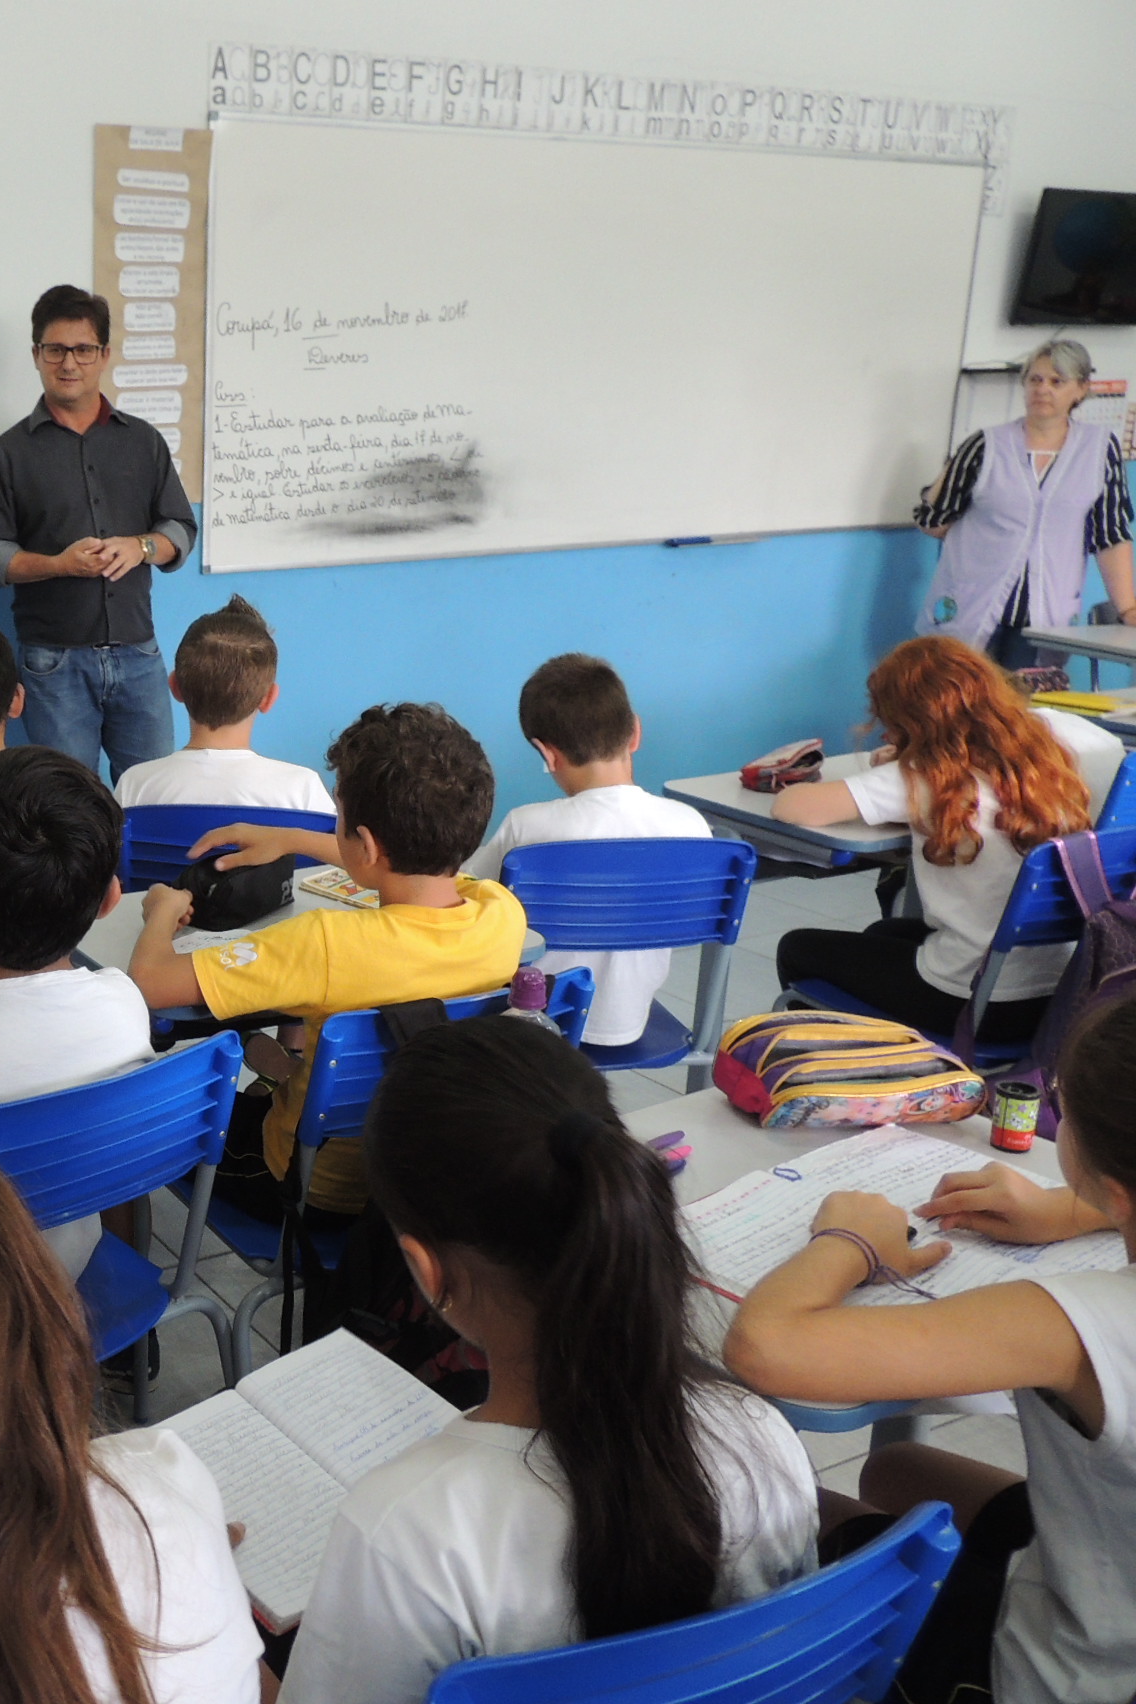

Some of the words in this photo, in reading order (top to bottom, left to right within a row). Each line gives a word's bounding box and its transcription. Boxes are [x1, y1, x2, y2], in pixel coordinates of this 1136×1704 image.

[212, 47, 228, 80] A
[254, 50, 271, 82] B
[295, 53, 311, 84] C
[334, 55, 351, 87] D
[372, 59, 388, 91] E
[409, 61, 425, 93] F
[447, 64, 463, 96] G
[482, 67, 499, 99] H
[551, 75, 565, 105] J
[584, 75, 599, 108] K
[618, 80, 631, 110] L
[648, 82, 665, 112] M
[680, 84, 697, 114] N
[712, 94, 727, 116] O
[743, 89, 757, 117] P
[771, 91, 785, 120] Q
[800, 94, 814, 122] R
[829, 96, 844, 124] S
[884, 99, 900, 129] U
[213, 86, 227, 105] a
[252, 89, 264, 109] b
[294, 91, 307, 110] c
[371, 96, 385, 116] e
[711, 121, 722, 138] o
[284, 306, 302, 333] 16
[312, 310, 331, 332] de
[337, 301, 409, 330] novembro
[415, 309, 432, 326] de
[299, 416, 336, 441] para
[340, 415, 353, 426] a
[355, 404, 419, 426] avaliação
[423, 403, 436, 422] de
[282, 445, 303, 458] na
[390, 433, 413, 449] dia
[430, 428, 443, 445] de
[229, 491, 239, 500] e
[282, 477, 335, 499] Estudar
[265, 460, 301, 486] sobre
[211, 511, 225, 527] de
[295, 501, 326, 521] desde
[330, 503, 341, 514] o
